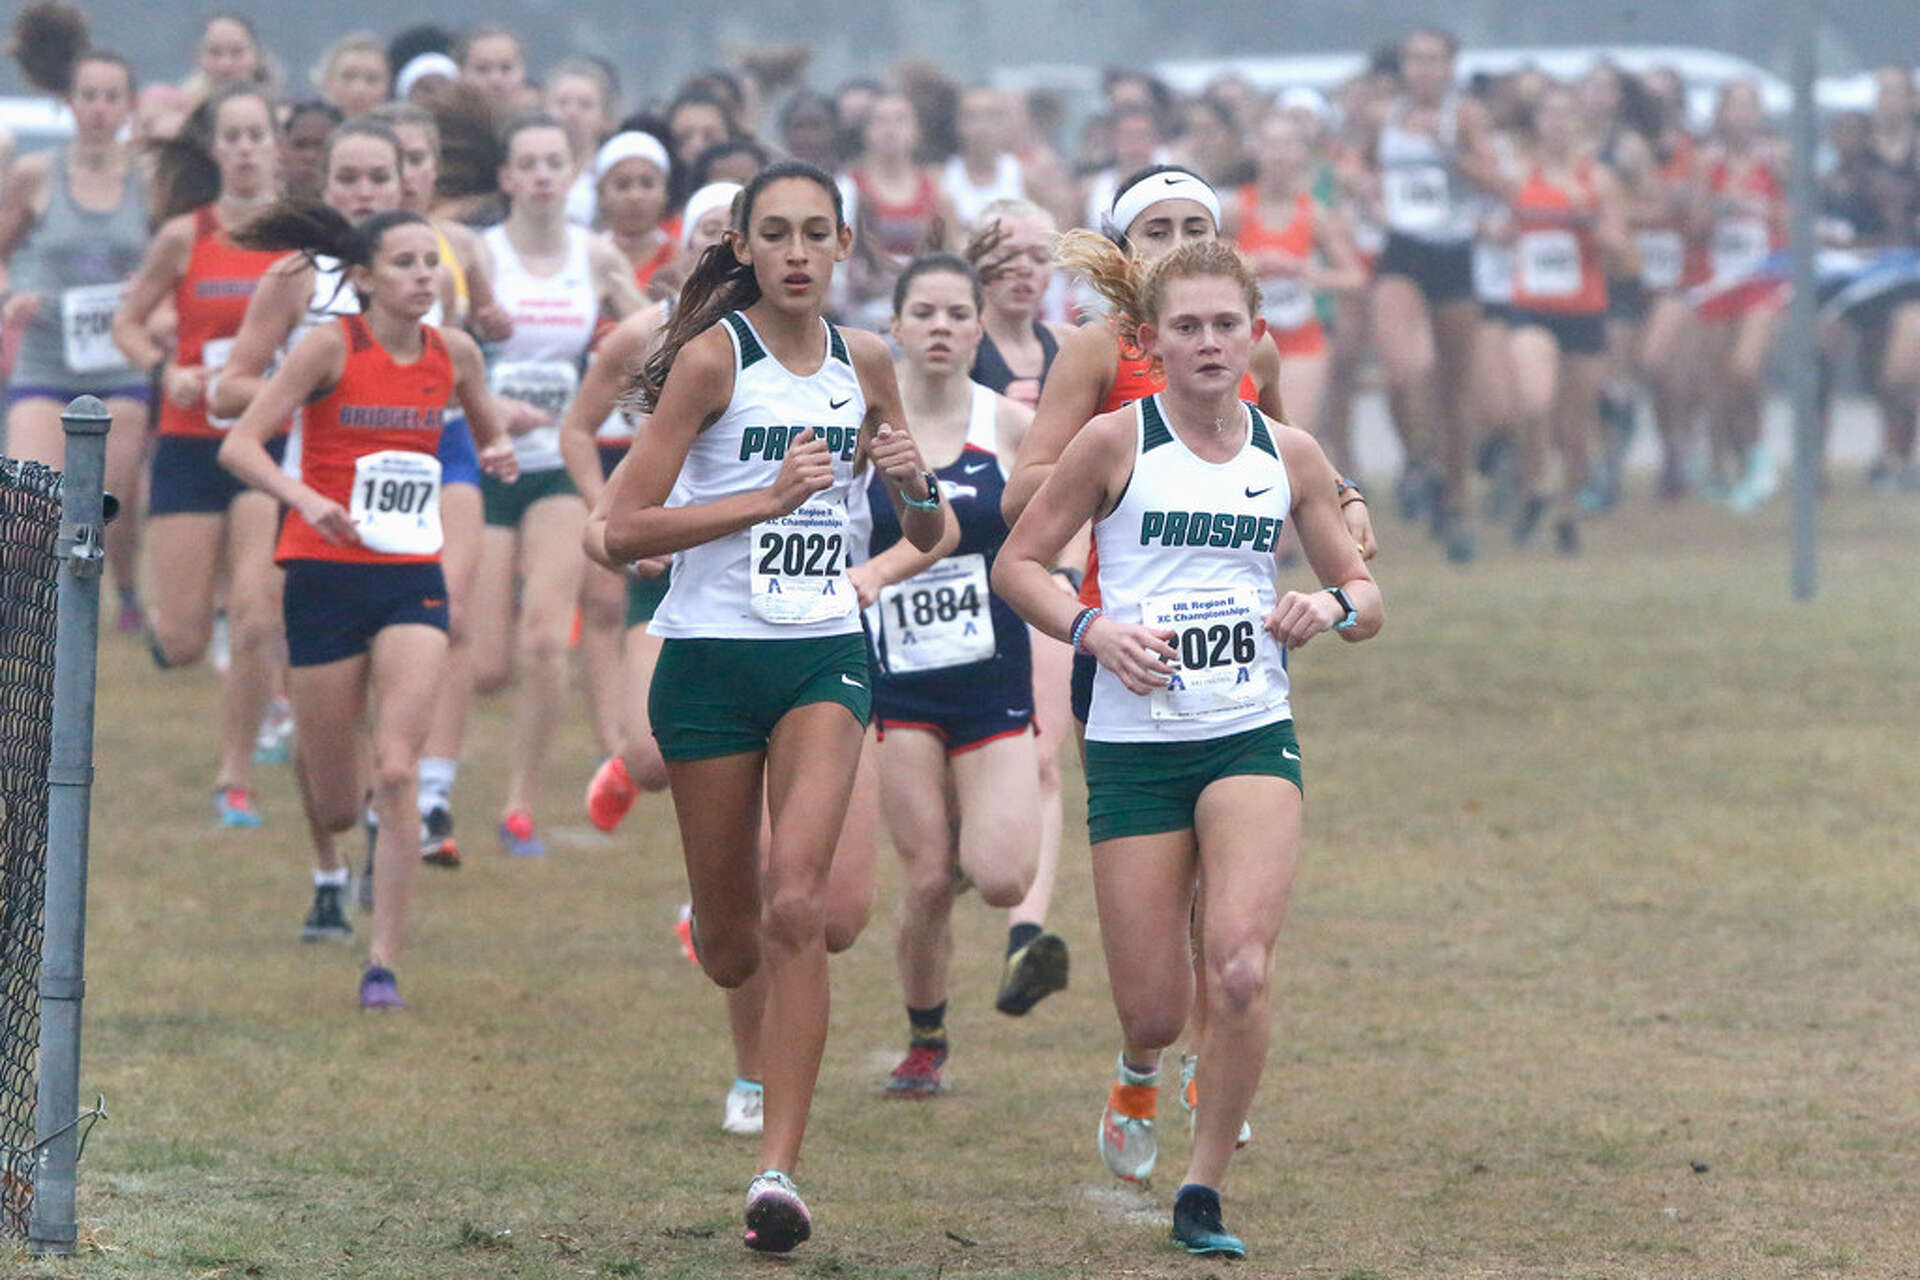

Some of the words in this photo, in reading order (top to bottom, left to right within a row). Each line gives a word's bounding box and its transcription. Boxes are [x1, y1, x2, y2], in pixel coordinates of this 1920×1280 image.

[364, 478, 433, 515] 1907
[759, 532, 843, 577] 2022
[890, 584, 980, 629] 1884
[1173, 607, 1250, 622] Championships
[1191, 599, 1227, 610] Region
